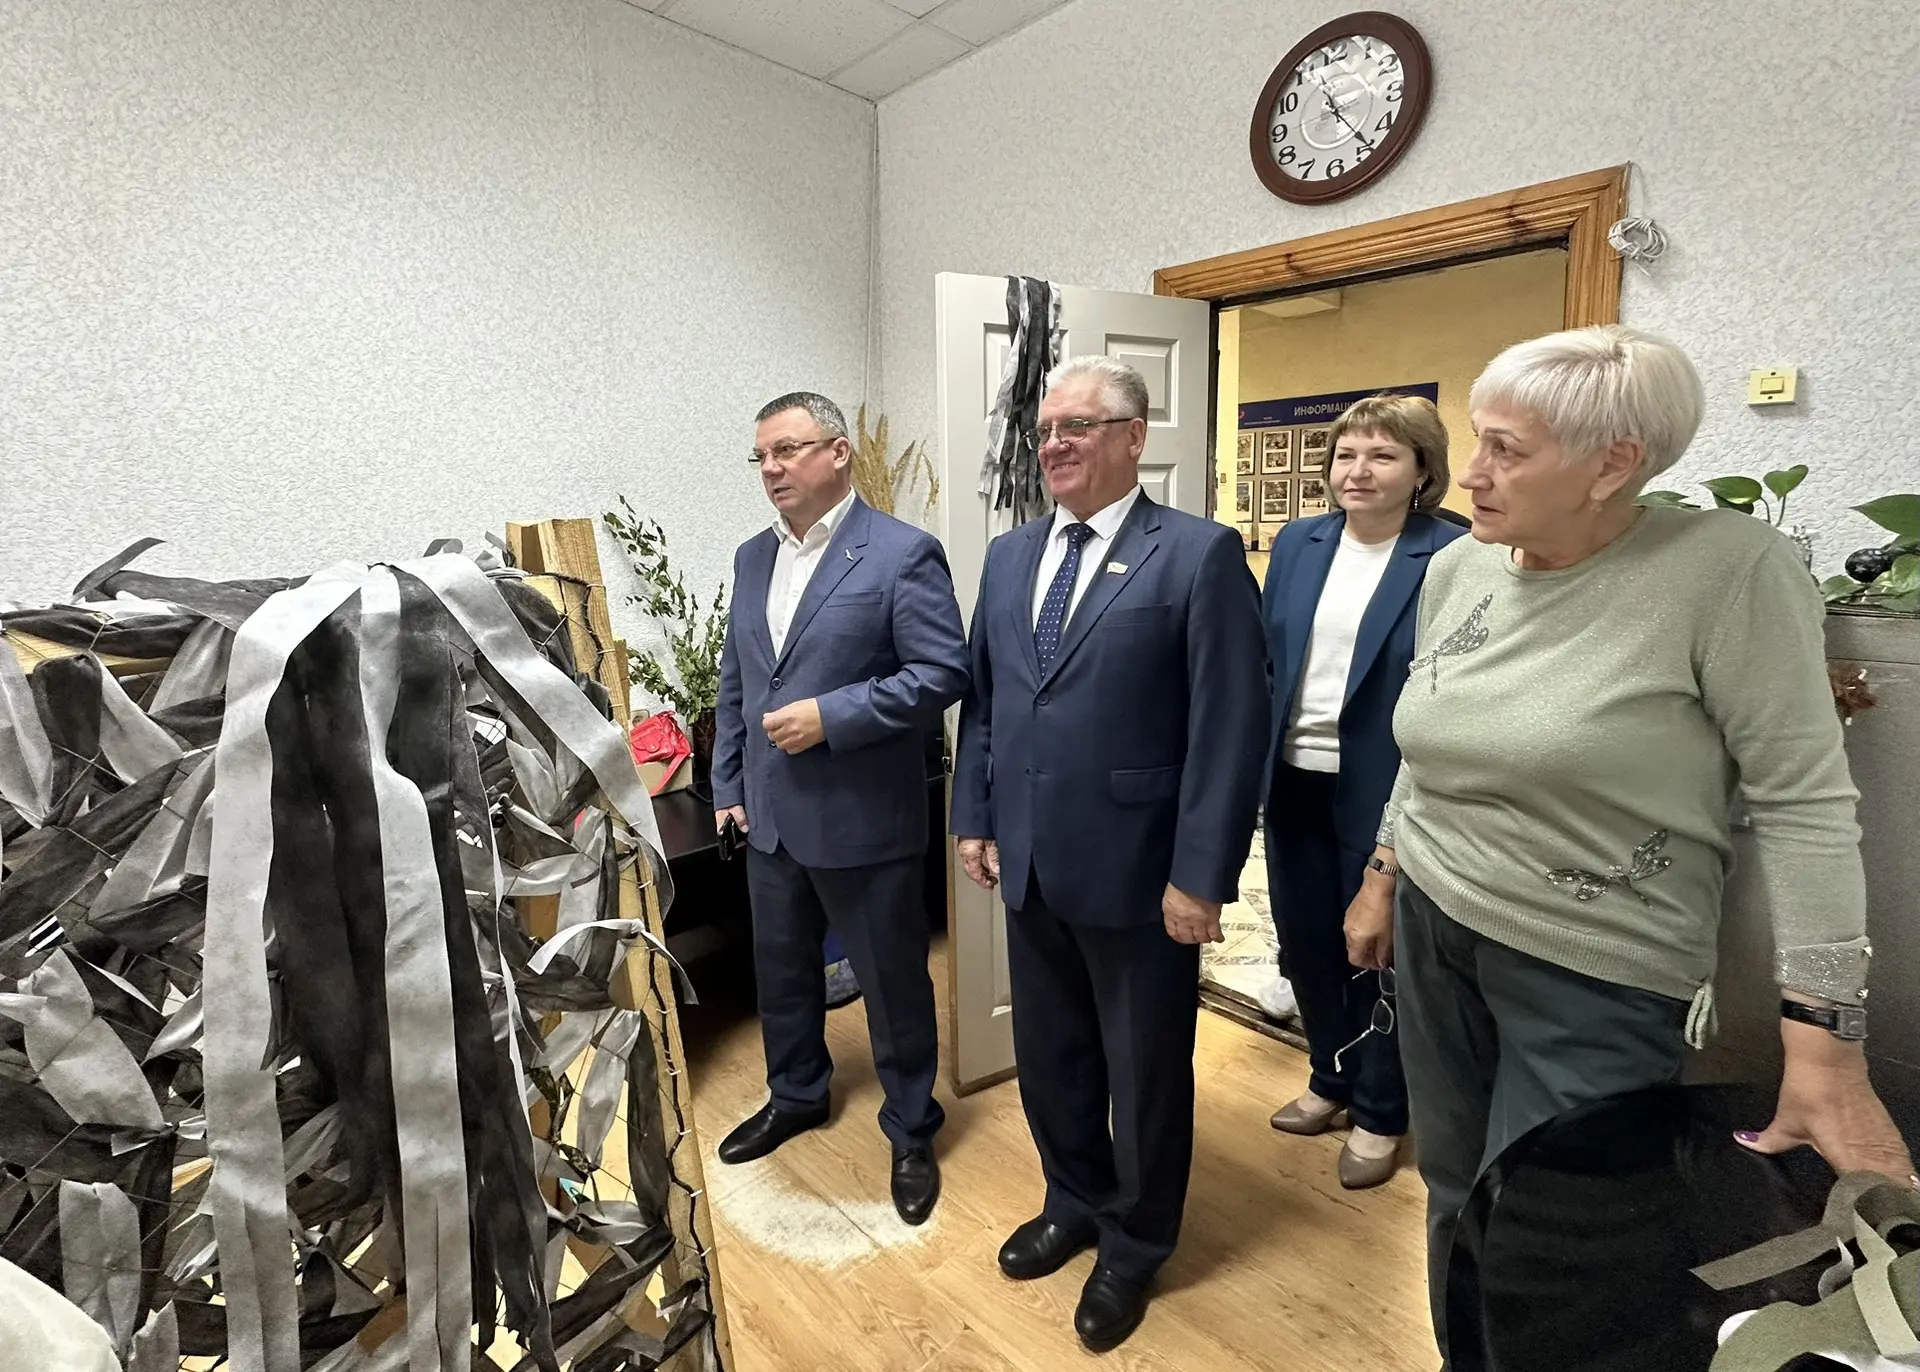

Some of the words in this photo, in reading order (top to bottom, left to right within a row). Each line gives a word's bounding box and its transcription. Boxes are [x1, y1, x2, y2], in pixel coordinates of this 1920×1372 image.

[1323, 41, 1349, 67] 12
[1377, 53, 1399, 77] 2
[1386, 80, 1403, 103] 3
[1278, 92, 1299, 116] 10
[1271, 123, 1288, 143] 9
[1374, 110, 1394, 133] 4
[1278, 145, 1297, 166] 8
[1356, 138, 1376, 162] 5
[1297, 158, 1316, 180] 7
[1325, 158, 1345, 179] 6
